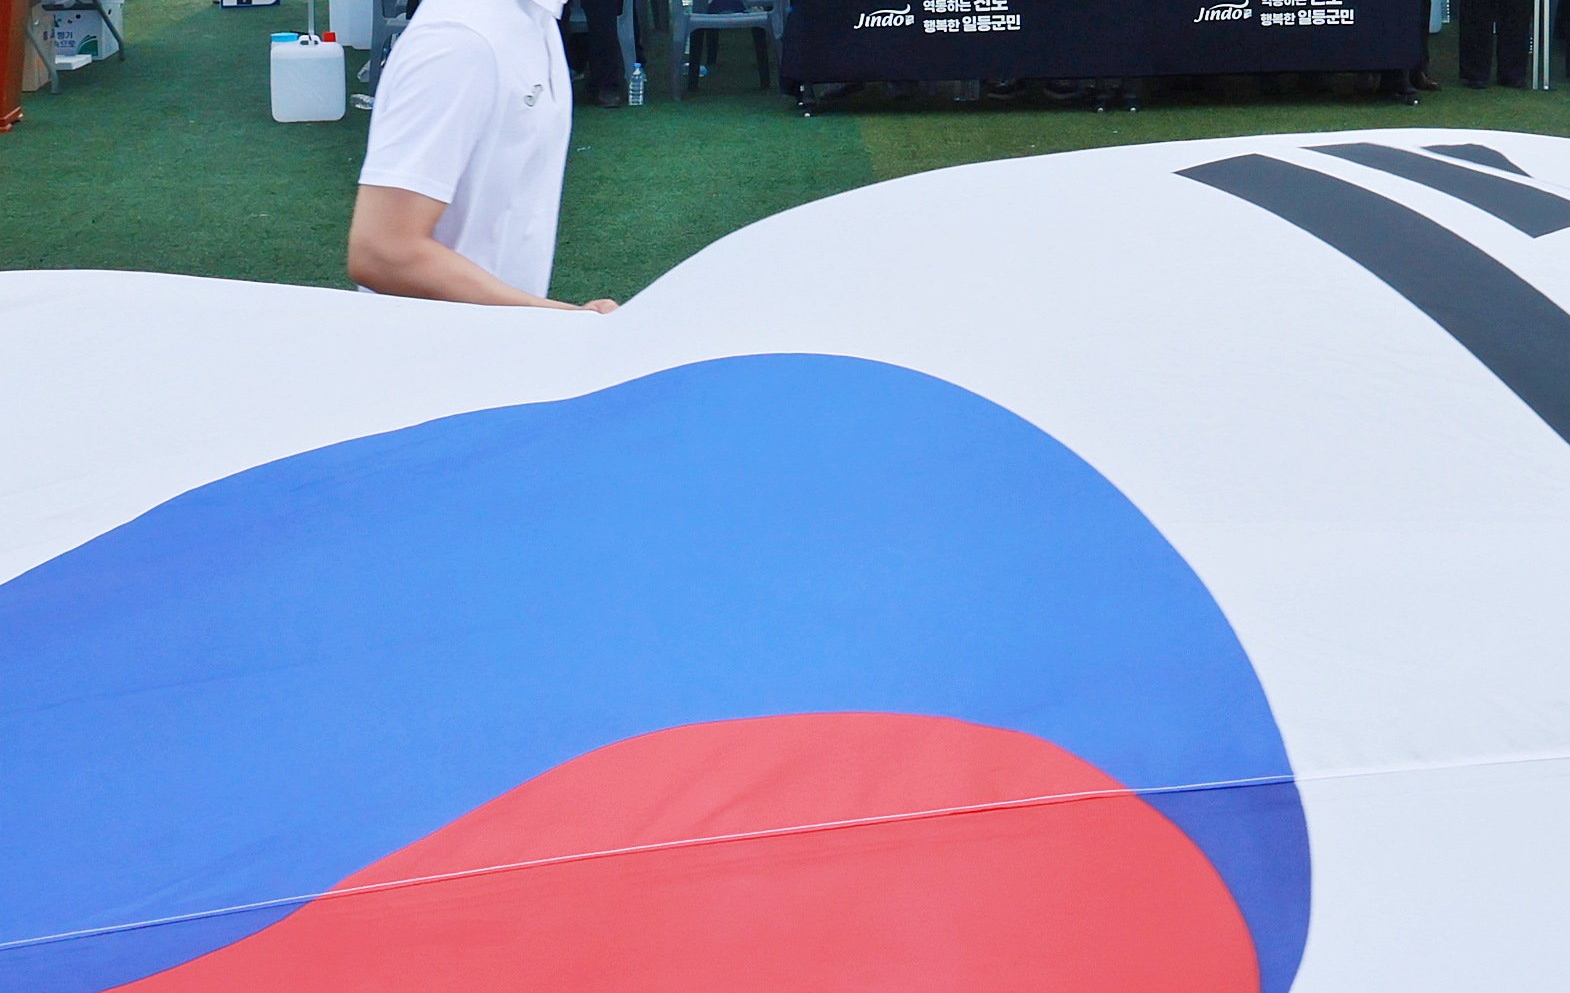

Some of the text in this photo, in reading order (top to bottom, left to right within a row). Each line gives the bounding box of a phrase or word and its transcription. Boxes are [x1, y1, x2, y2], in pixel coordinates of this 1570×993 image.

[923, 0, 971, 13] 역동하는
[1193, 0, 1244, 23] Jindo
[853, 6, 906, 29] Jindo
[922, 14, 1021, 33] 행복한 일등군민
[1260, 9, 1355, 26] 행복한 일등군민
